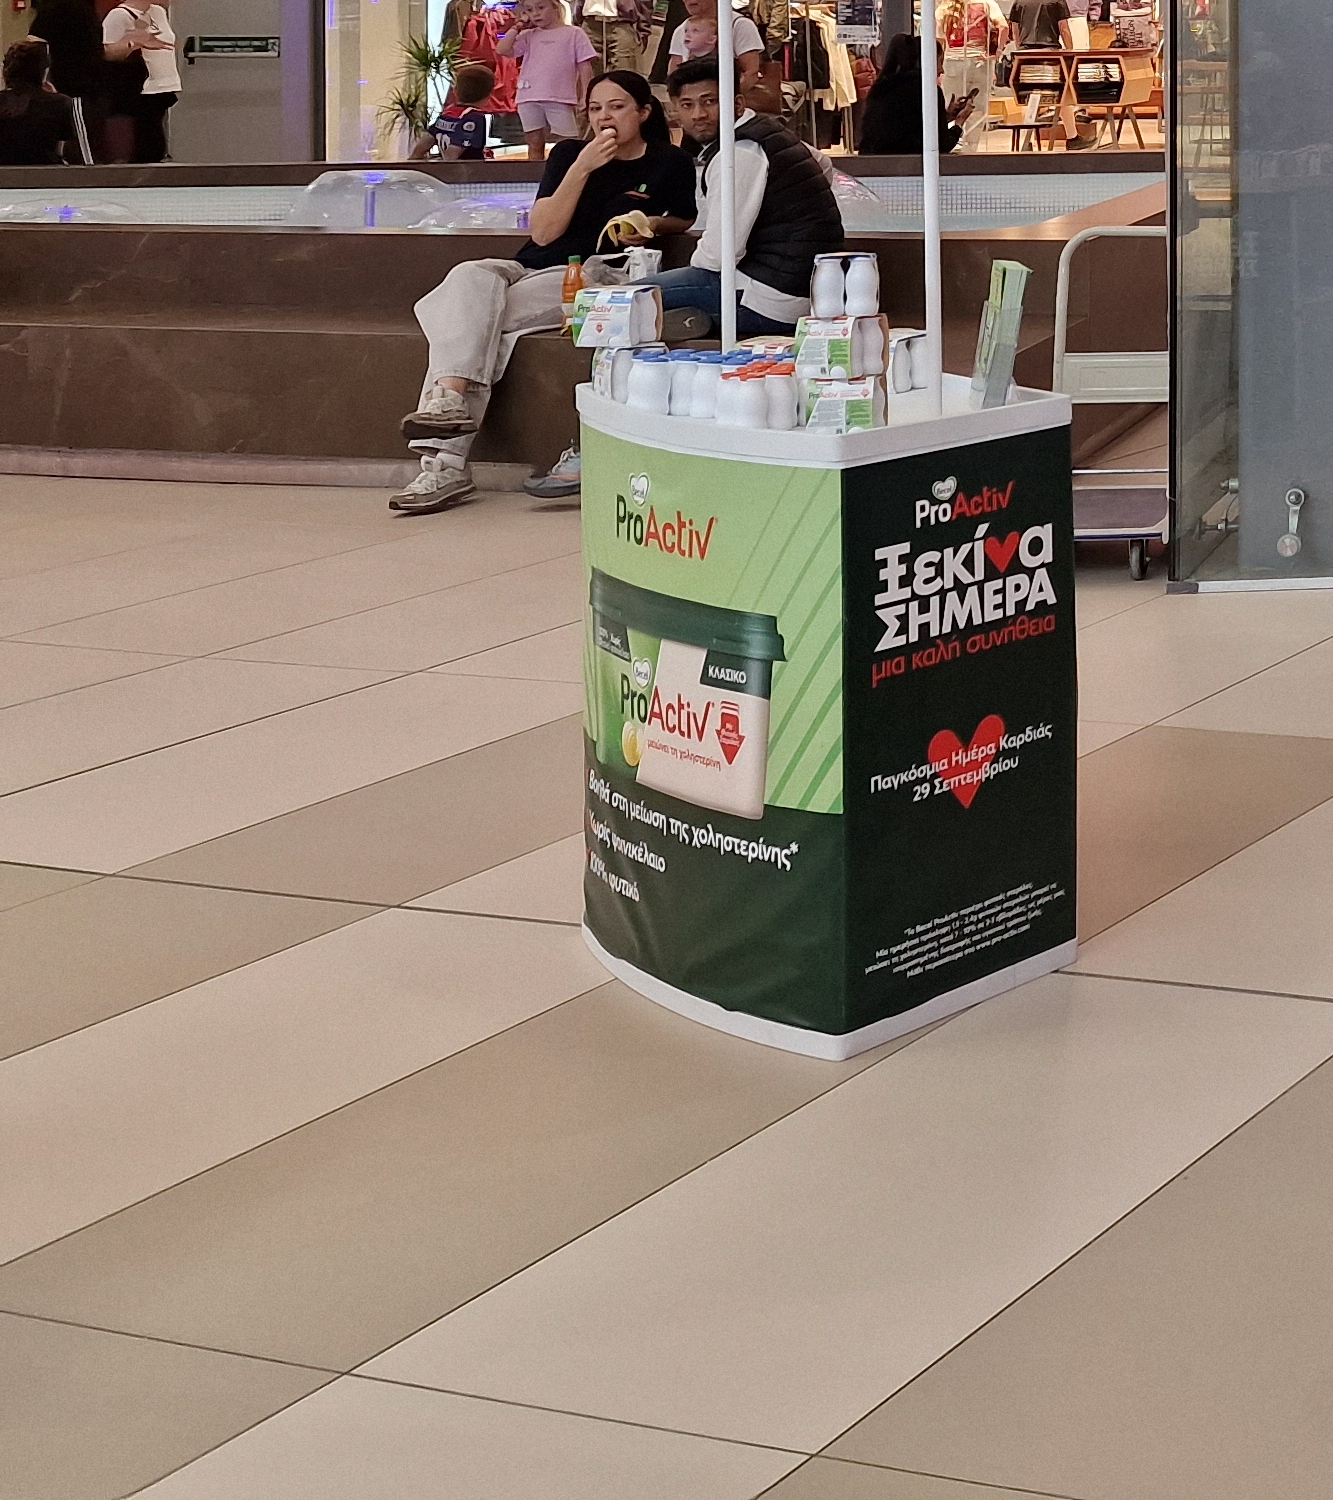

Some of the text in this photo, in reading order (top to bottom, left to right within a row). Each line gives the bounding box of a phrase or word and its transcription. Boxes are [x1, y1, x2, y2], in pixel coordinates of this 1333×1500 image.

[616, 493, 716, 561] ProActiv
[915, 480, 1016, 529] ProActiv
[873, 567, 1058, 653] ΣΗΜΕΡΑ
[708, 664, 748, 685] ΚΛΑΣΙΚΟ
[872, 614, 1057, 688] μια καλή συνήθεια
[620, 672, 714, 743] ProActiv
[869, 721, 1054, 794] Παγκόσμια Ημέρα Καρδιάς
[911, 755, 1020, 803] 29 Σεπτεμβρίου
[629, 800, 668, 836] μείωση
[669, 817, 690, 844] της
